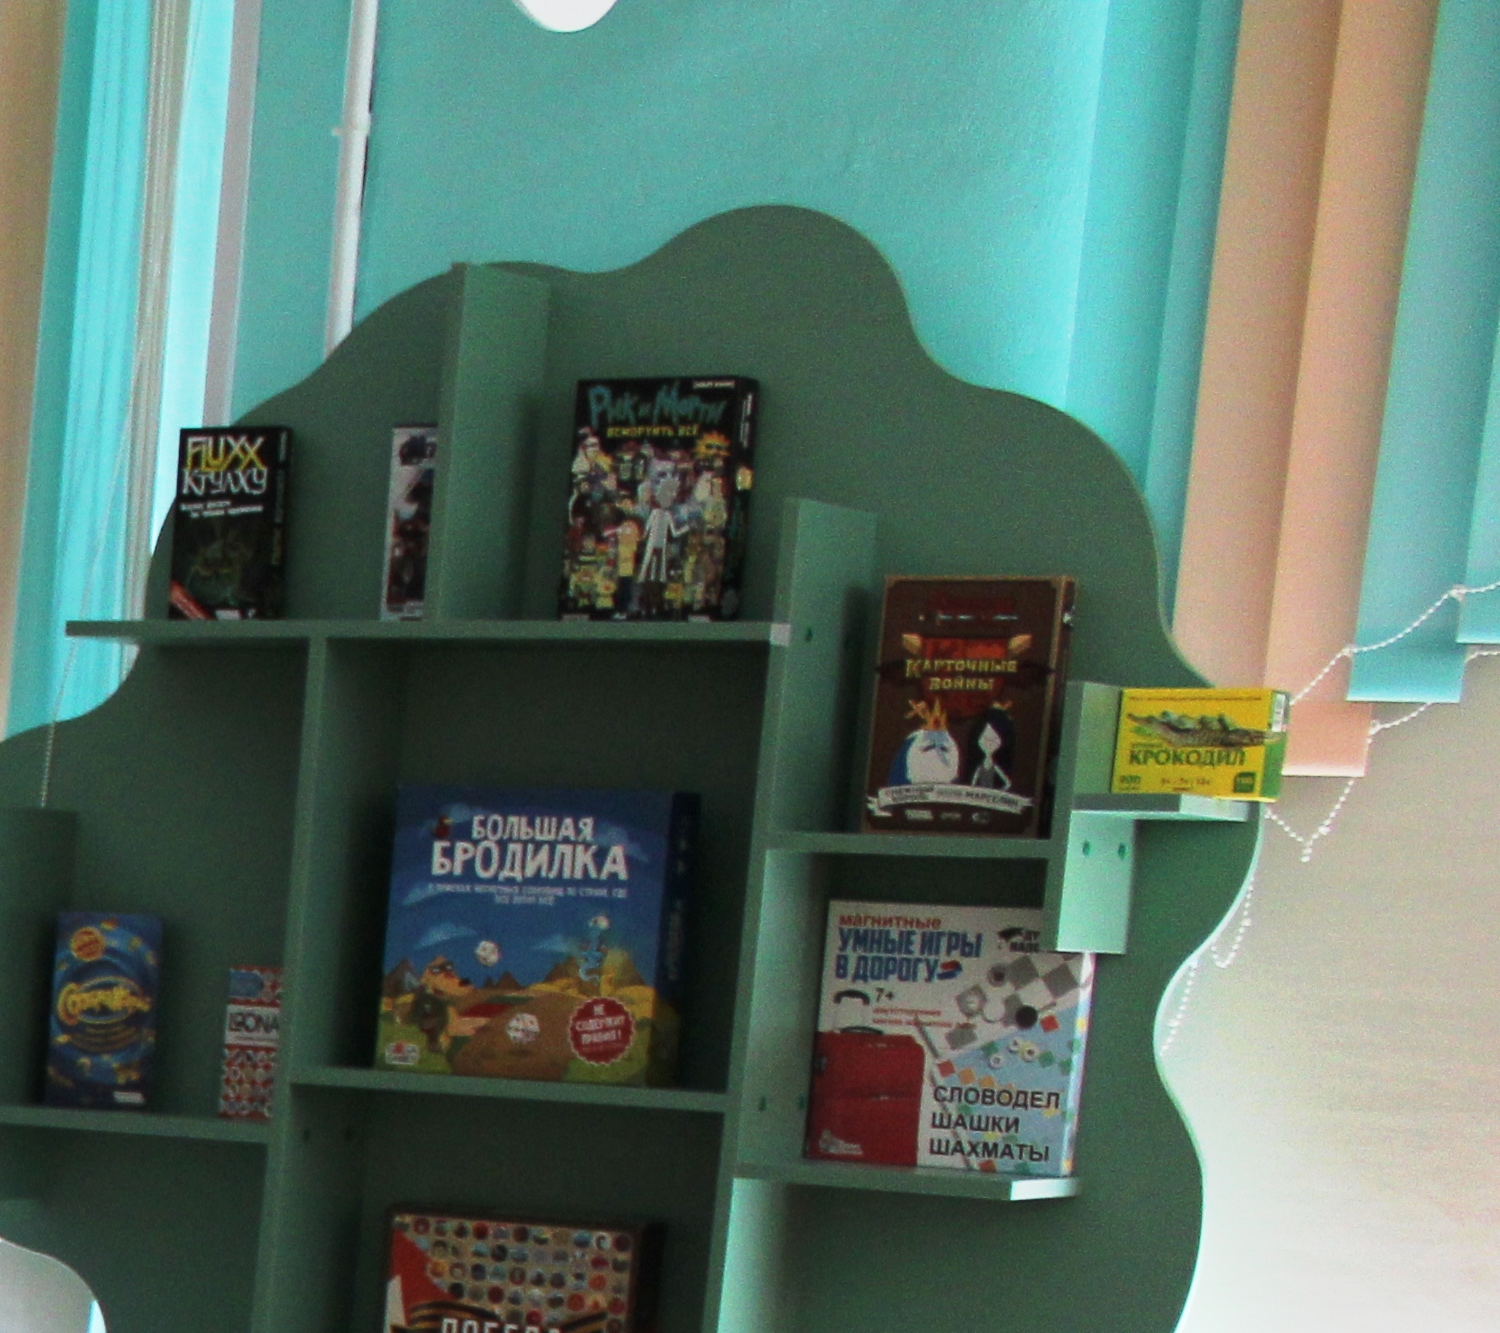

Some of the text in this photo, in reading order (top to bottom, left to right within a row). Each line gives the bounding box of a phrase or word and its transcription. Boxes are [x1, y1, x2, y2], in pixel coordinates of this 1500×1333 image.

[186, 435, 267, 472] FLUXX
[1129, 749, 1246, 769] КРОКОДИЛ
[472, 814, 595, 842] БОЛЬШАЯ
[431, 841, 630, 882] БРОДИЛКА
[838, 927, 917, 955] УМНЫЕ
[919, 931, 983, 958] ИГРЫ
[835, 955, 940, 983] В ДОРОГУ
[933, 1085, 1060, 1110] СЛОВОДЕЛ
[930, 1112, 1020, 1134] ШАШКИ
[929, 1137, 1050, 1162] ШАХМАТЫ
